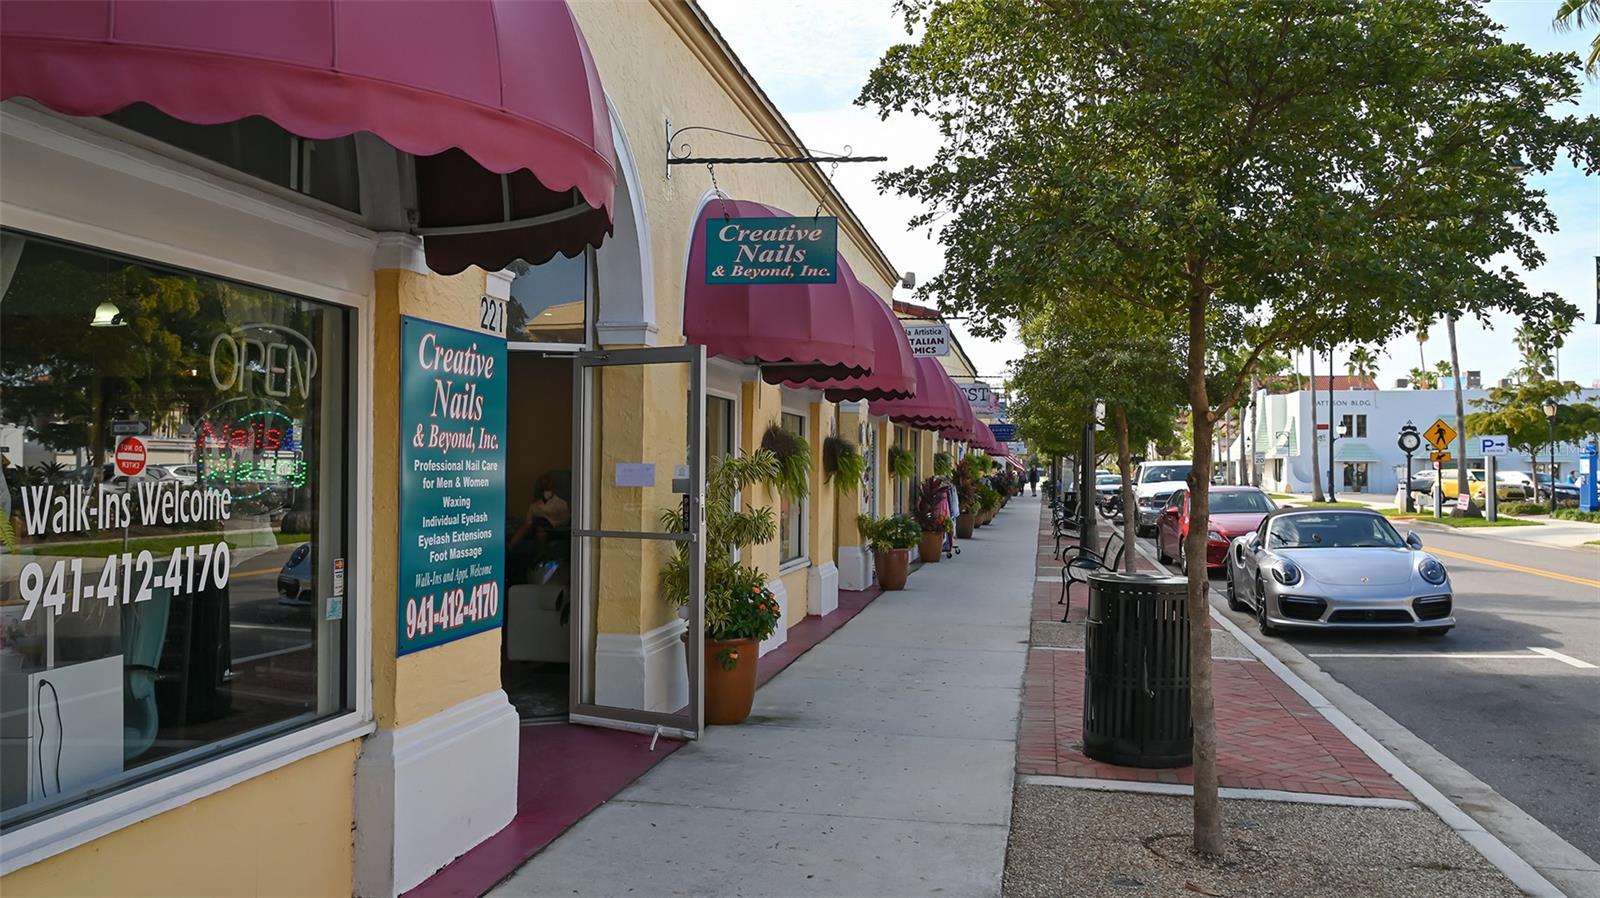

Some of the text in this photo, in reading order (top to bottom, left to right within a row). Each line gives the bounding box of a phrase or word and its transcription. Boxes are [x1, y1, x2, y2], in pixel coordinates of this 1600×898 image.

[719, 224, 822, 242] Creative
[733, 244, 807, 263] Nails
[712, 265, 831, 279] & Beyond, Inc.
[480, 297, 503, 333] 221
[209, 333, 311, 400] OPEN
[418, 333, 494, 379] Creative
[430, 378, 484, 421] Nails
[197, 421, 282, 449] Nails
[413, 423, 499, 454] & Beyond, Inc.
[1482, 439, 1494, 452] P
[414, 459, 498, 472] Professional Nail Care
[422, 476, 489, 489] for Men & Women
[21, 480, 232, 536] Walk-Ins Welcome
[442, 496, 471, 509] Waxing
[422, 511, 488, 528] Individual Eyelash
[418, 528, 492, 549] Eyelash Extensions
[430, 546, 482, 563] Foot Massage
[19, 541, 231, 621] 941-412-4170
[415, 563, 493, 589] Walk-Ins and Appt. Welcome
[406, 581, 499, 640] 941-412-4170
